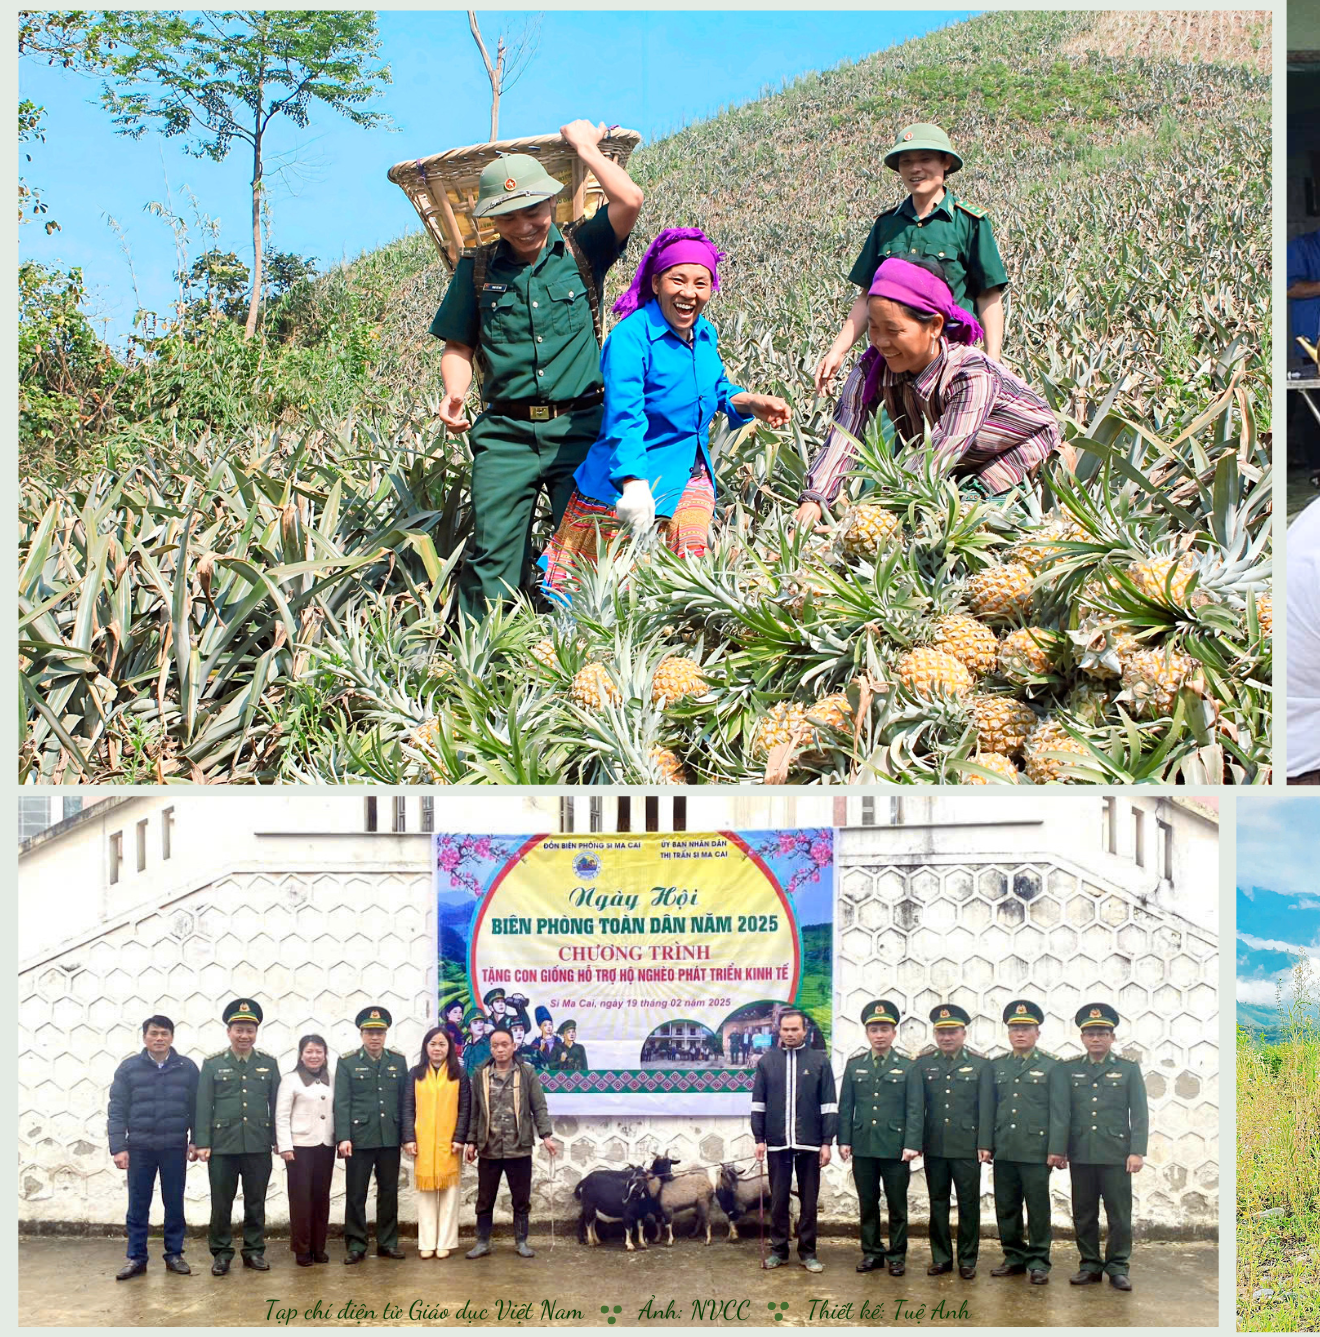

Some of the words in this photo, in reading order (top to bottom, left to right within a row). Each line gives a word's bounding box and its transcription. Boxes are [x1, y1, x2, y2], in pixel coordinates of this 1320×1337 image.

[688, 840, 710, 848] NHÂN
[693, 851, 700, 859] SI
[568, 886, 639, 911] Ngày
[650, 886, 700, 910] Hội
[491, 914, 532, 935] BIÊN
[536, 914, 594, 935] PHÒNG
[598, 914, 645, 935] TOÀN
[650, 913, 688, 934] DÂN
[690, 912, 732, 934] NĂM
[737, 914, 779, 933] 2025
[558, 944, 643, 962] CHƯƠNG
[648, 941, 711, 961] TRÌNH
[482, 966, 511, 984] TẶNG
[514, 968, 538, 983] CON
[540, 965, 575, 983] GIỐNG
[577, 964, 593, 983] HỖ
[596, 967, 618, 984] TRỢ
[620, 966, 635, 985] HỘ
[637, 965, 675, 983] NGHÈO
[677, 965, 707, 982] PHÁT
[709, 962, 743, 981] TRIỂN
[745, 967, 773, 981] KINH
[775, 962, 789, 980] TẾ
[550, 999, 560, 1008] Si
[562, 999, 576, 1008] Ma
[600, 998, 623, 1010] ngày
[626, 999, 638, 1008] 19
[640, 998, 668, 1010] tháng
[670, 999, 682, 1008] 02
[684, 998, 706, 1008] năm
[708, 998, 731, 1007] 2025
